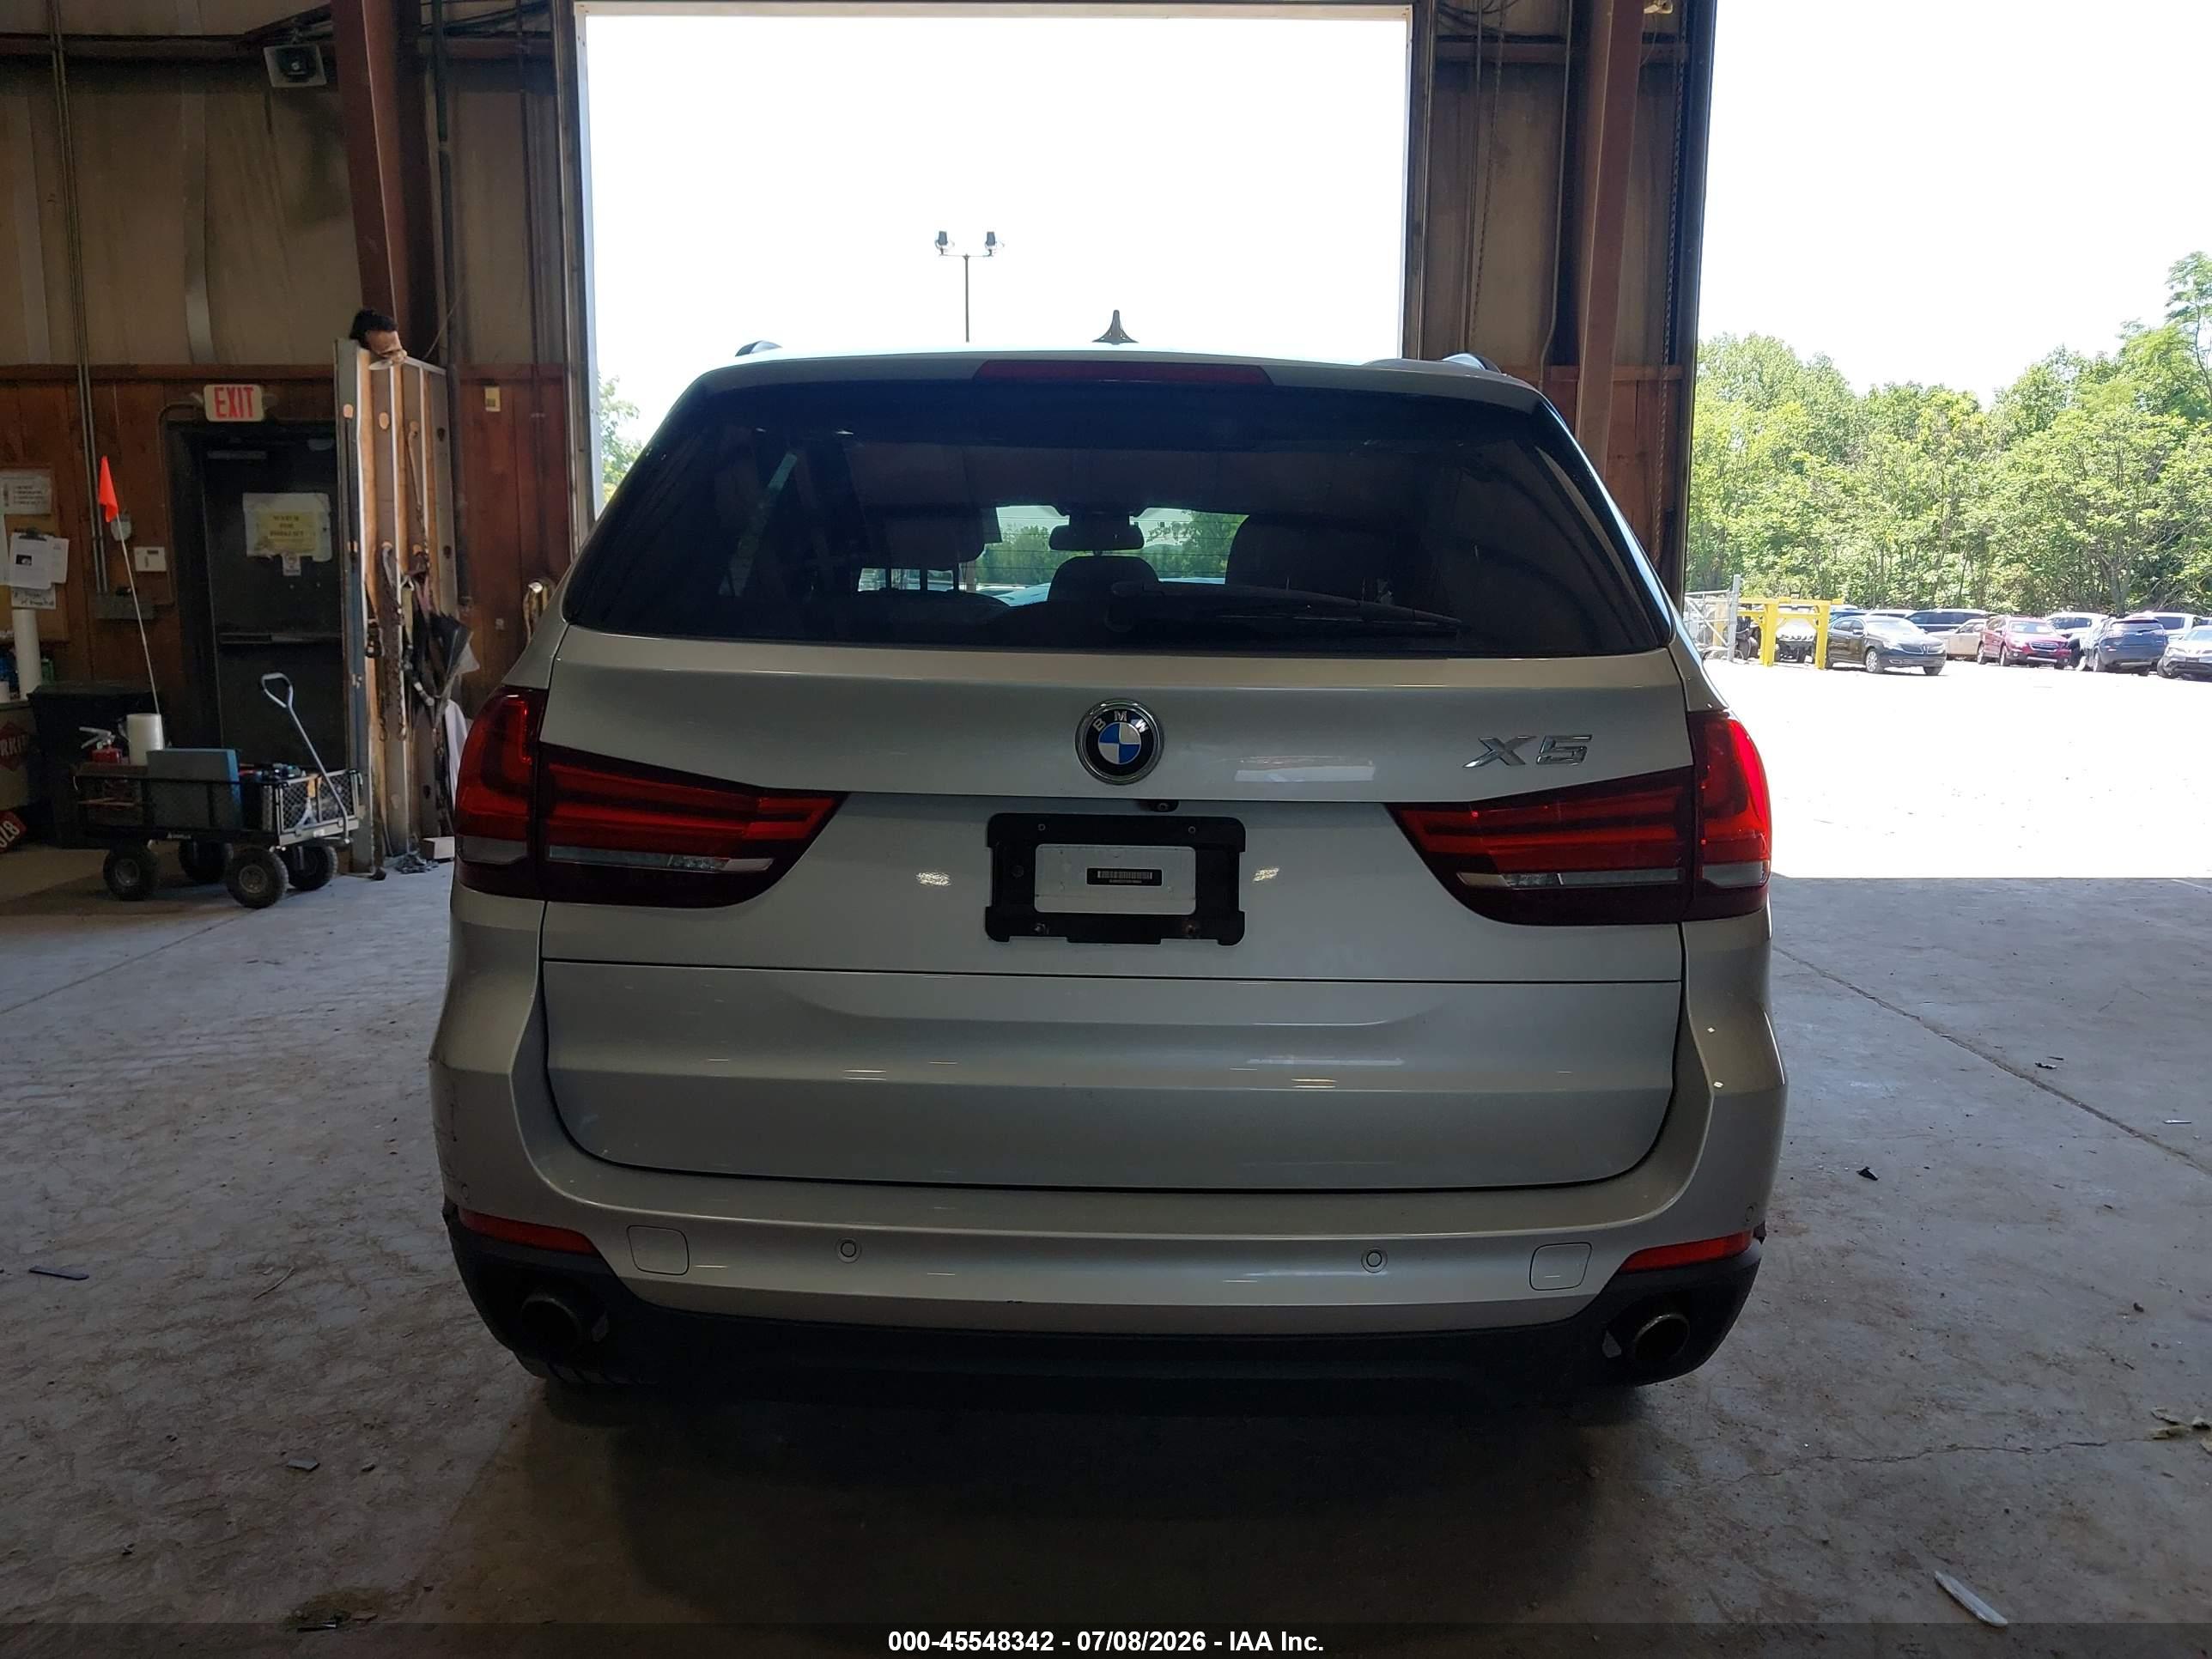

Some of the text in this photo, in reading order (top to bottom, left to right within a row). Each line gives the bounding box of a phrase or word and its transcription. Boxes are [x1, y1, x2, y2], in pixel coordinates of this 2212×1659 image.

[214, 386, 254, 418] EXIT
[1092, 711, 1149, 733] BMW
[1462, 734, 1593, 768] X5
